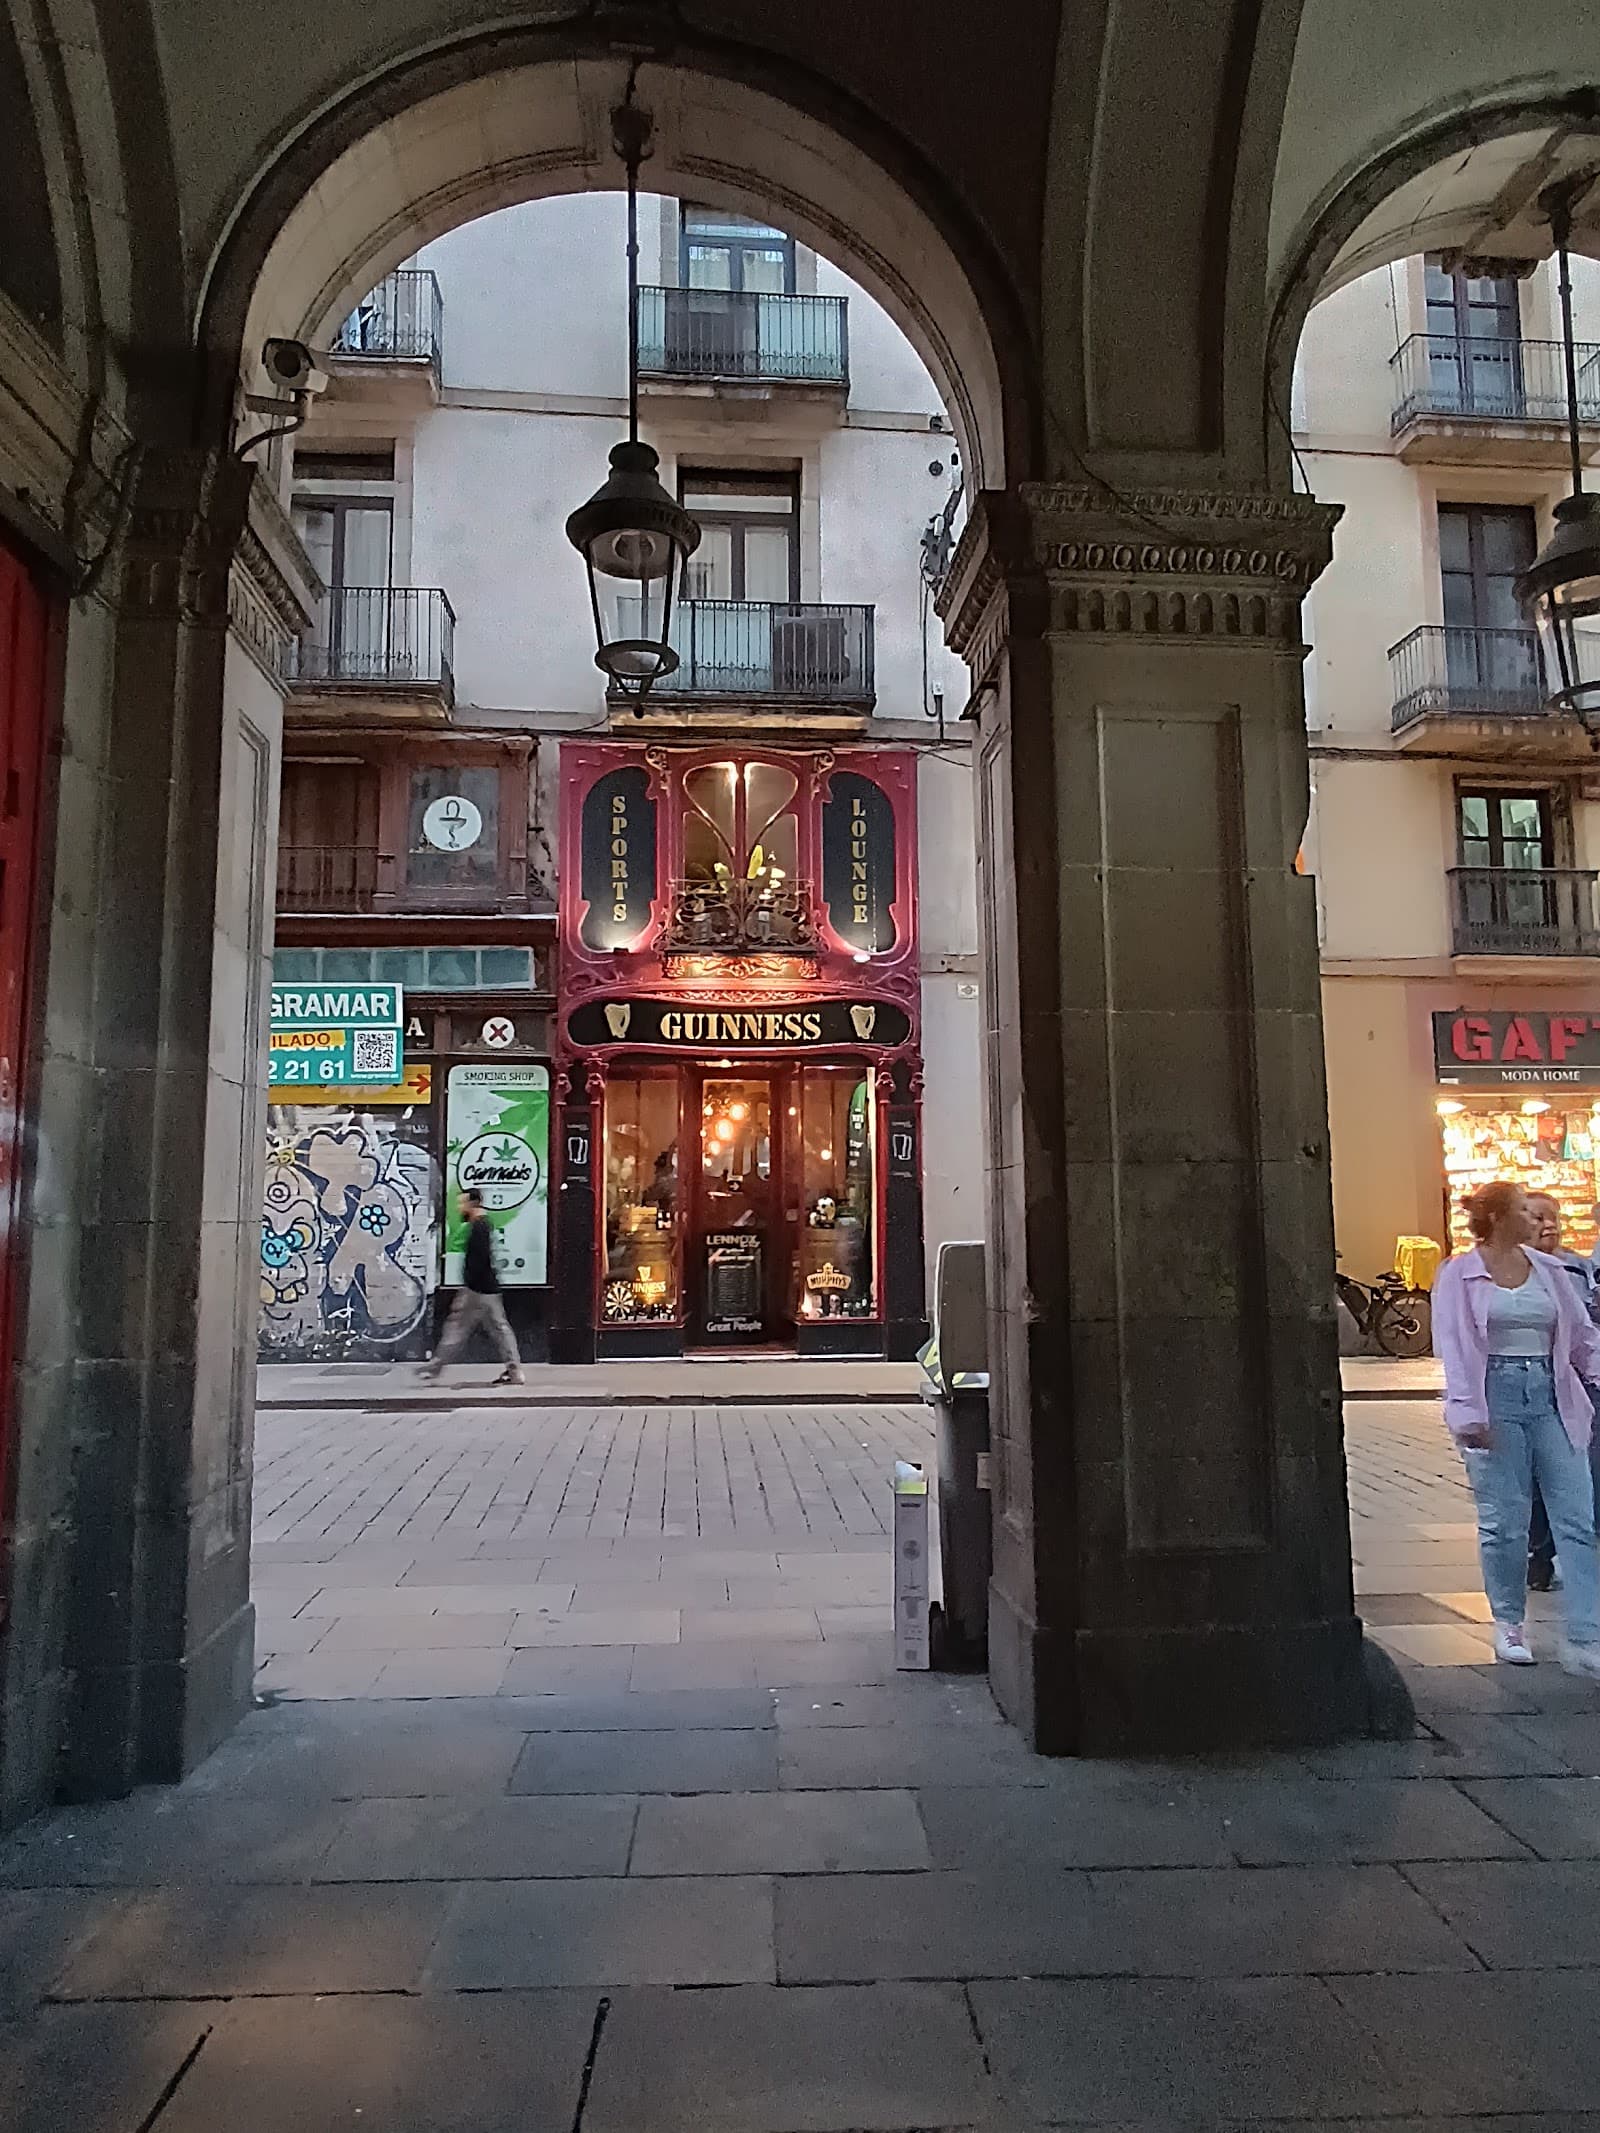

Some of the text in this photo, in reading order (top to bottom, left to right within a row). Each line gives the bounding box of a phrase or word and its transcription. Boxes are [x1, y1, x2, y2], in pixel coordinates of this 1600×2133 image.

[611, 795, 629, 922] SPORTS
[850, 798, 869, 924] LOUNGE
[405, 1016, 426, 1037] A
[660, 1012, 823, 1042] GUINNESS
[1452, 1017, 1600, 1062] GAF
[284, 1059, 310, 1080] 21
[319, 1059, 345, 1080] 61
[464, 1071, 535, 1081] SMOKING SHOP
[1501, 1070, 1581, 1081] MODA HOME
[475, 1146, 490, 1163] I
[463, 1162, 532, 1181] Cannabis
[706, 1234, 757, 1246] LENNOX
[706, 1320, 763, 1334] Great People
